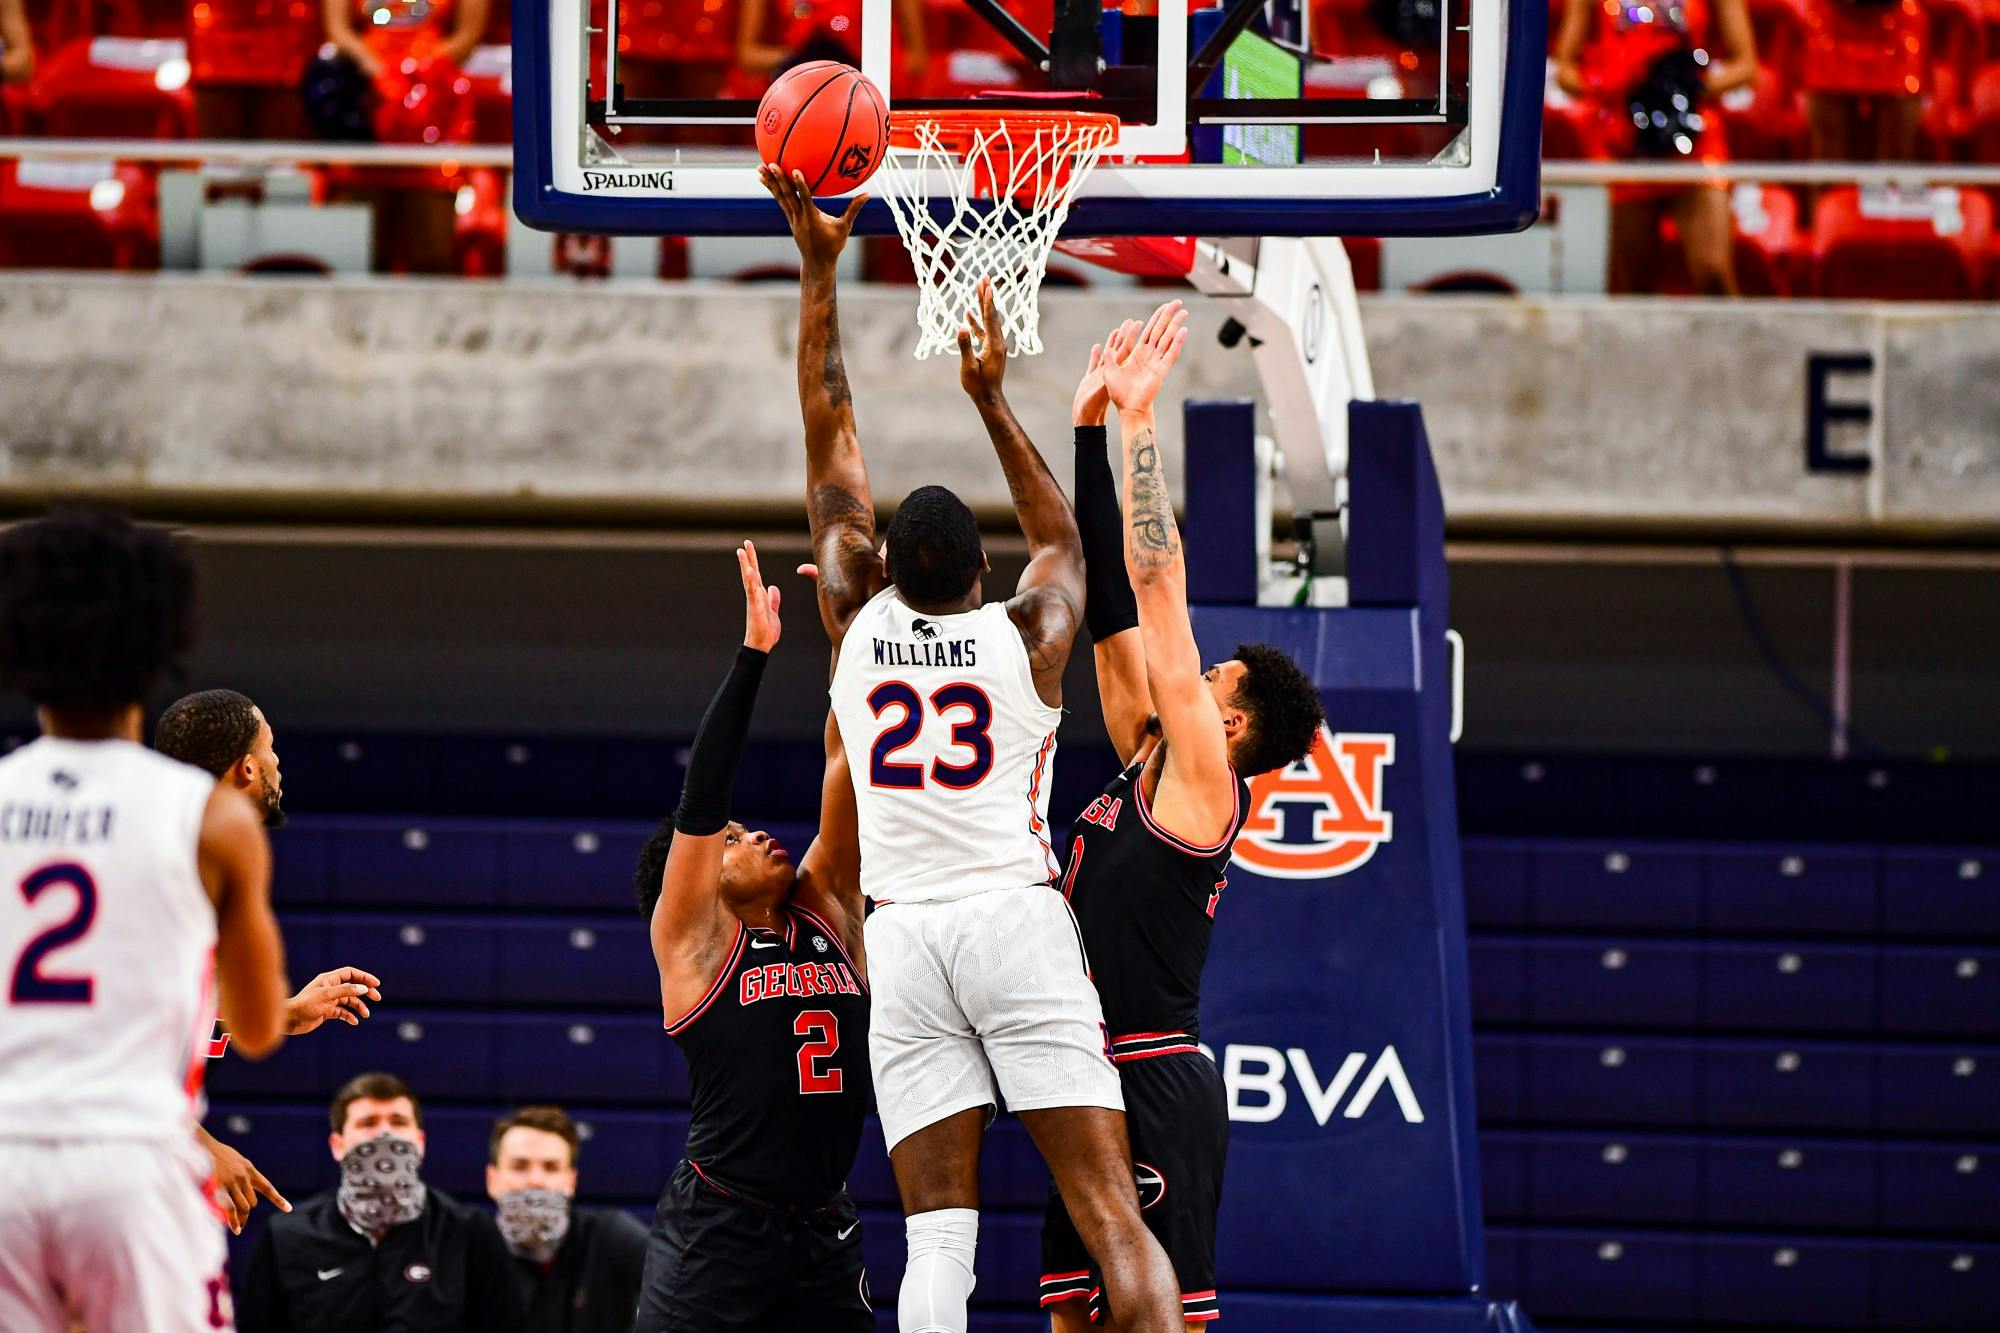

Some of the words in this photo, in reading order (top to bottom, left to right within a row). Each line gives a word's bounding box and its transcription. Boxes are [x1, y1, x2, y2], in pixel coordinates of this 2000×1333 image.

[583, 171, 673, 191] SPALDING
[1806, 352, 1873, 473] E
[872, 638, 976, 667] WILLIAMS
[866, 680, 995, 790] 23
[9, 861, 98, 1006] 2
[739, 961, 861, 1006] GEORGIA
[793, 1009, 843, 1095] 2
[1199, 1043, 1425, 1127] BVA
